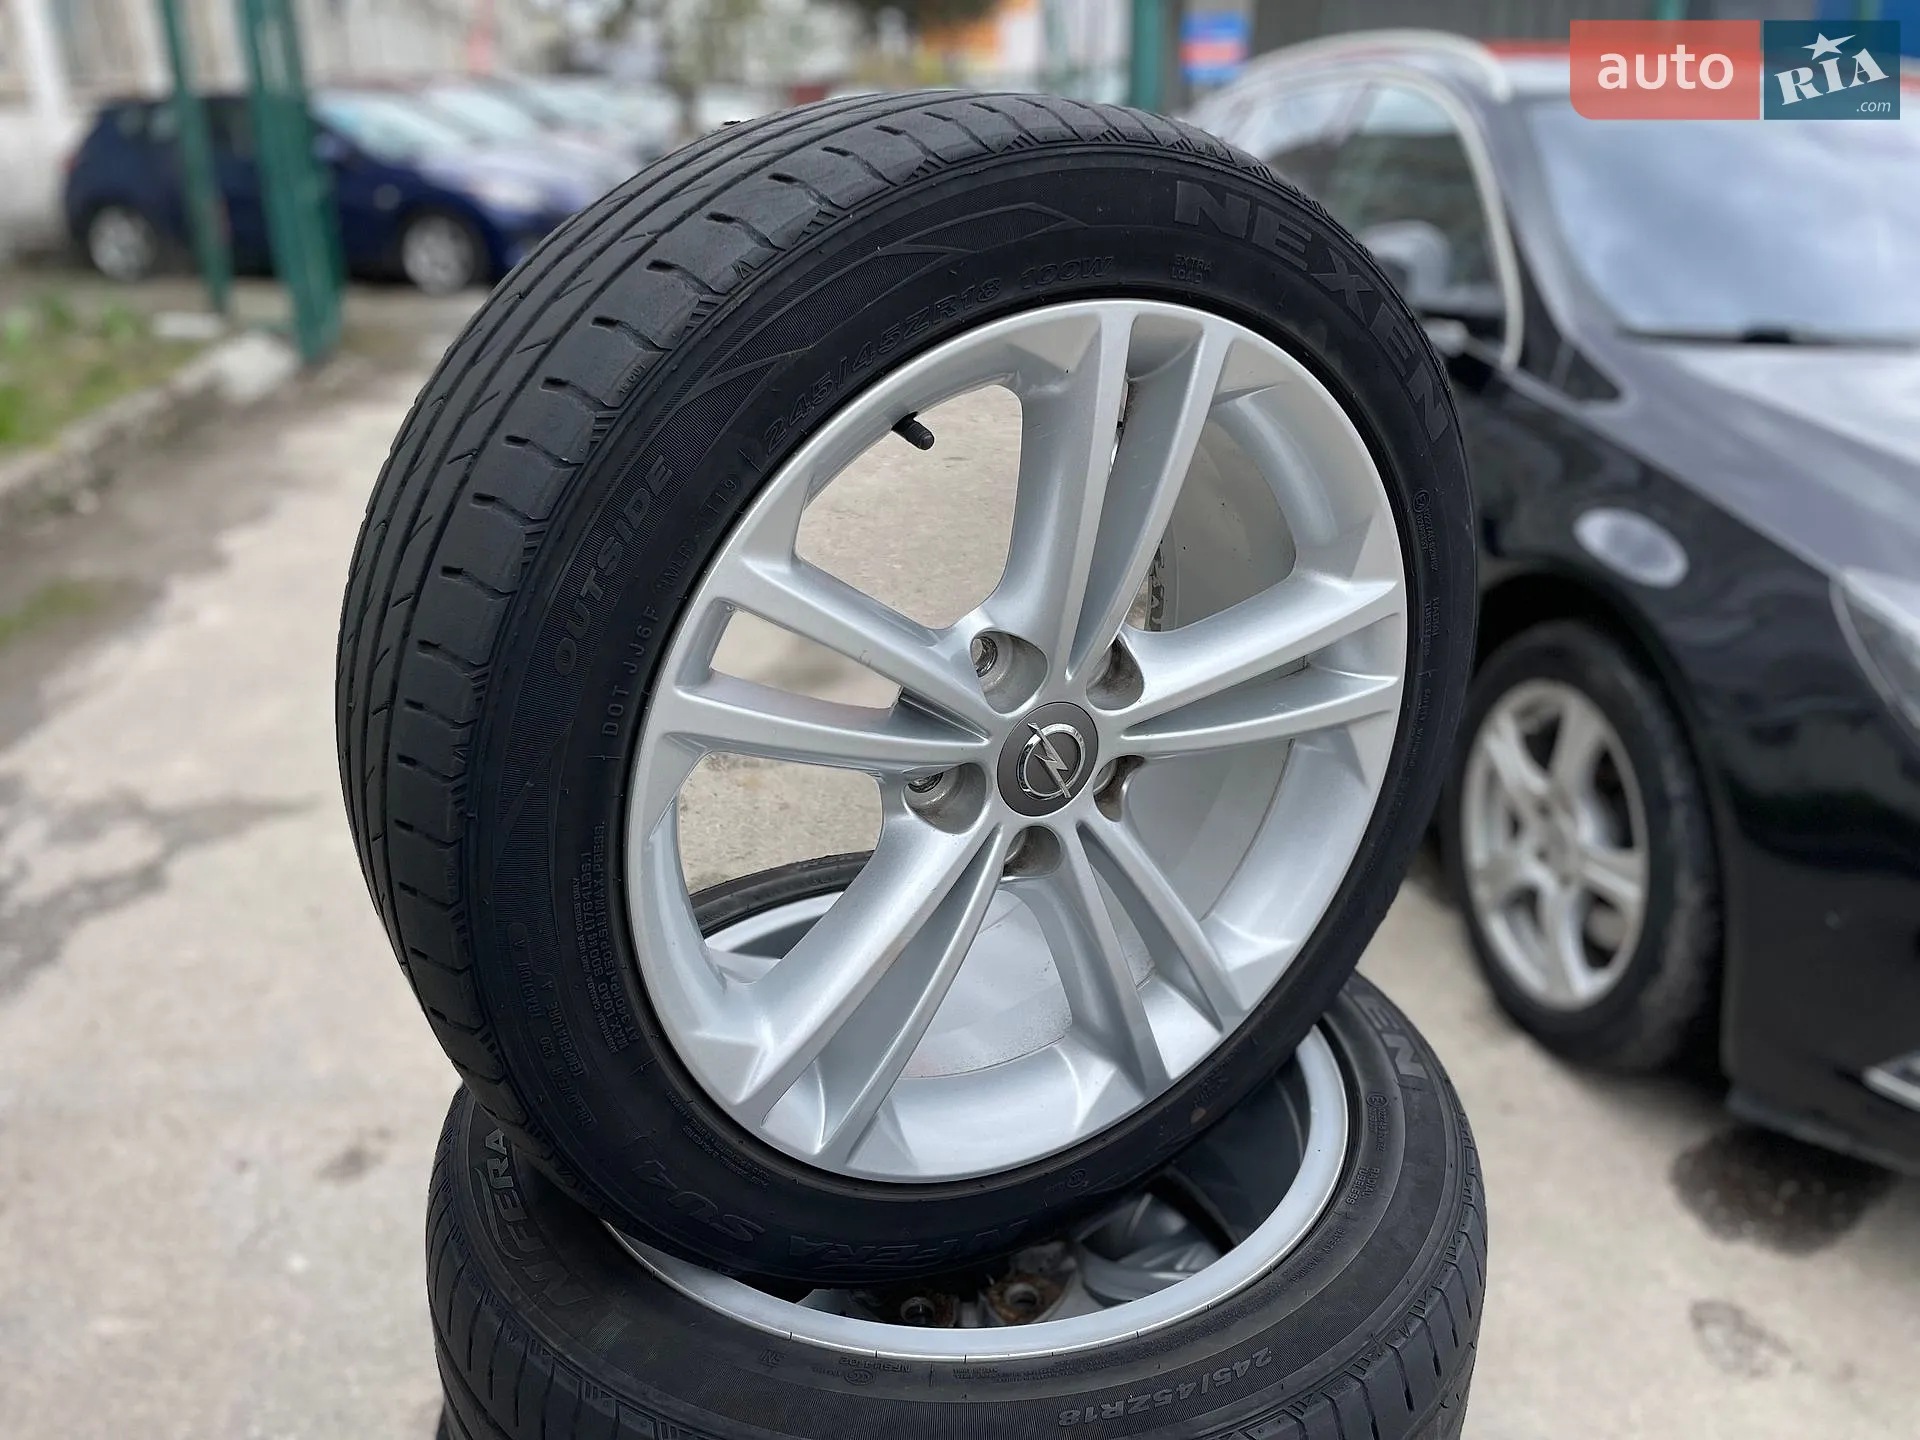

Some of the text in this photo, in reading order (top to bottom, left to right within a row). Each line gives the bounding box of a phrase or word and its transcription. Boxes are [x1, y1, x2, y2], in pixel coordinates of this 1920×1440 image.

[764, 256, 1116, 455] 245/45ZR18 100W
[1174, 180, 1449, 443] NEXEN
[554, 455, 672, 676] OUTSIDE
[601, 685, 630, 737] DOT
[1058, 1346, 1273, 1427] 245/45ZR18
